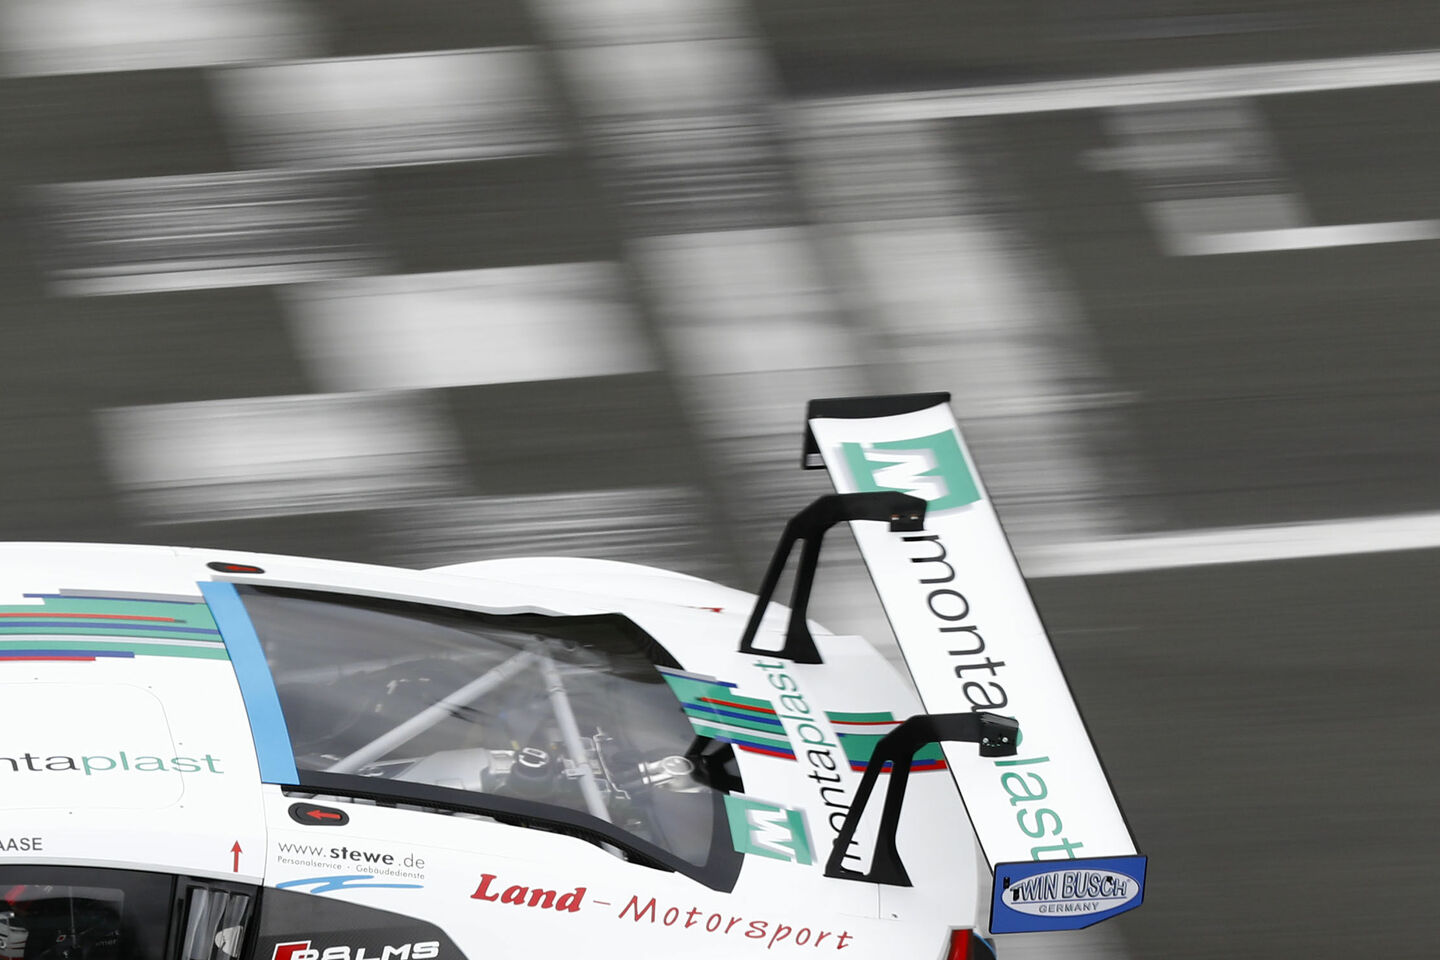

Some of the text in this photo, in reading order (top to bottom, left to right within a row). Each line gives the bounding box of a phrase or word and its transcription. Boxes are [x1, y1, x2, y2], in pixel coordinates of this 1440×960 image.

[900, 530, 1084, 861] montalast
[753, 659, 863, 876] ontaplast
[277, 855, 342, 870] Personalservice
[278, 842, 426, 870] www.stewe.de
[1010, 871, 1128, 902] TWIN BUSCH
[471, 873, 589, 913] Land
[617, 895, 853, 950] Motorsport
[1038, 902, 1100, 913] GERMANY
